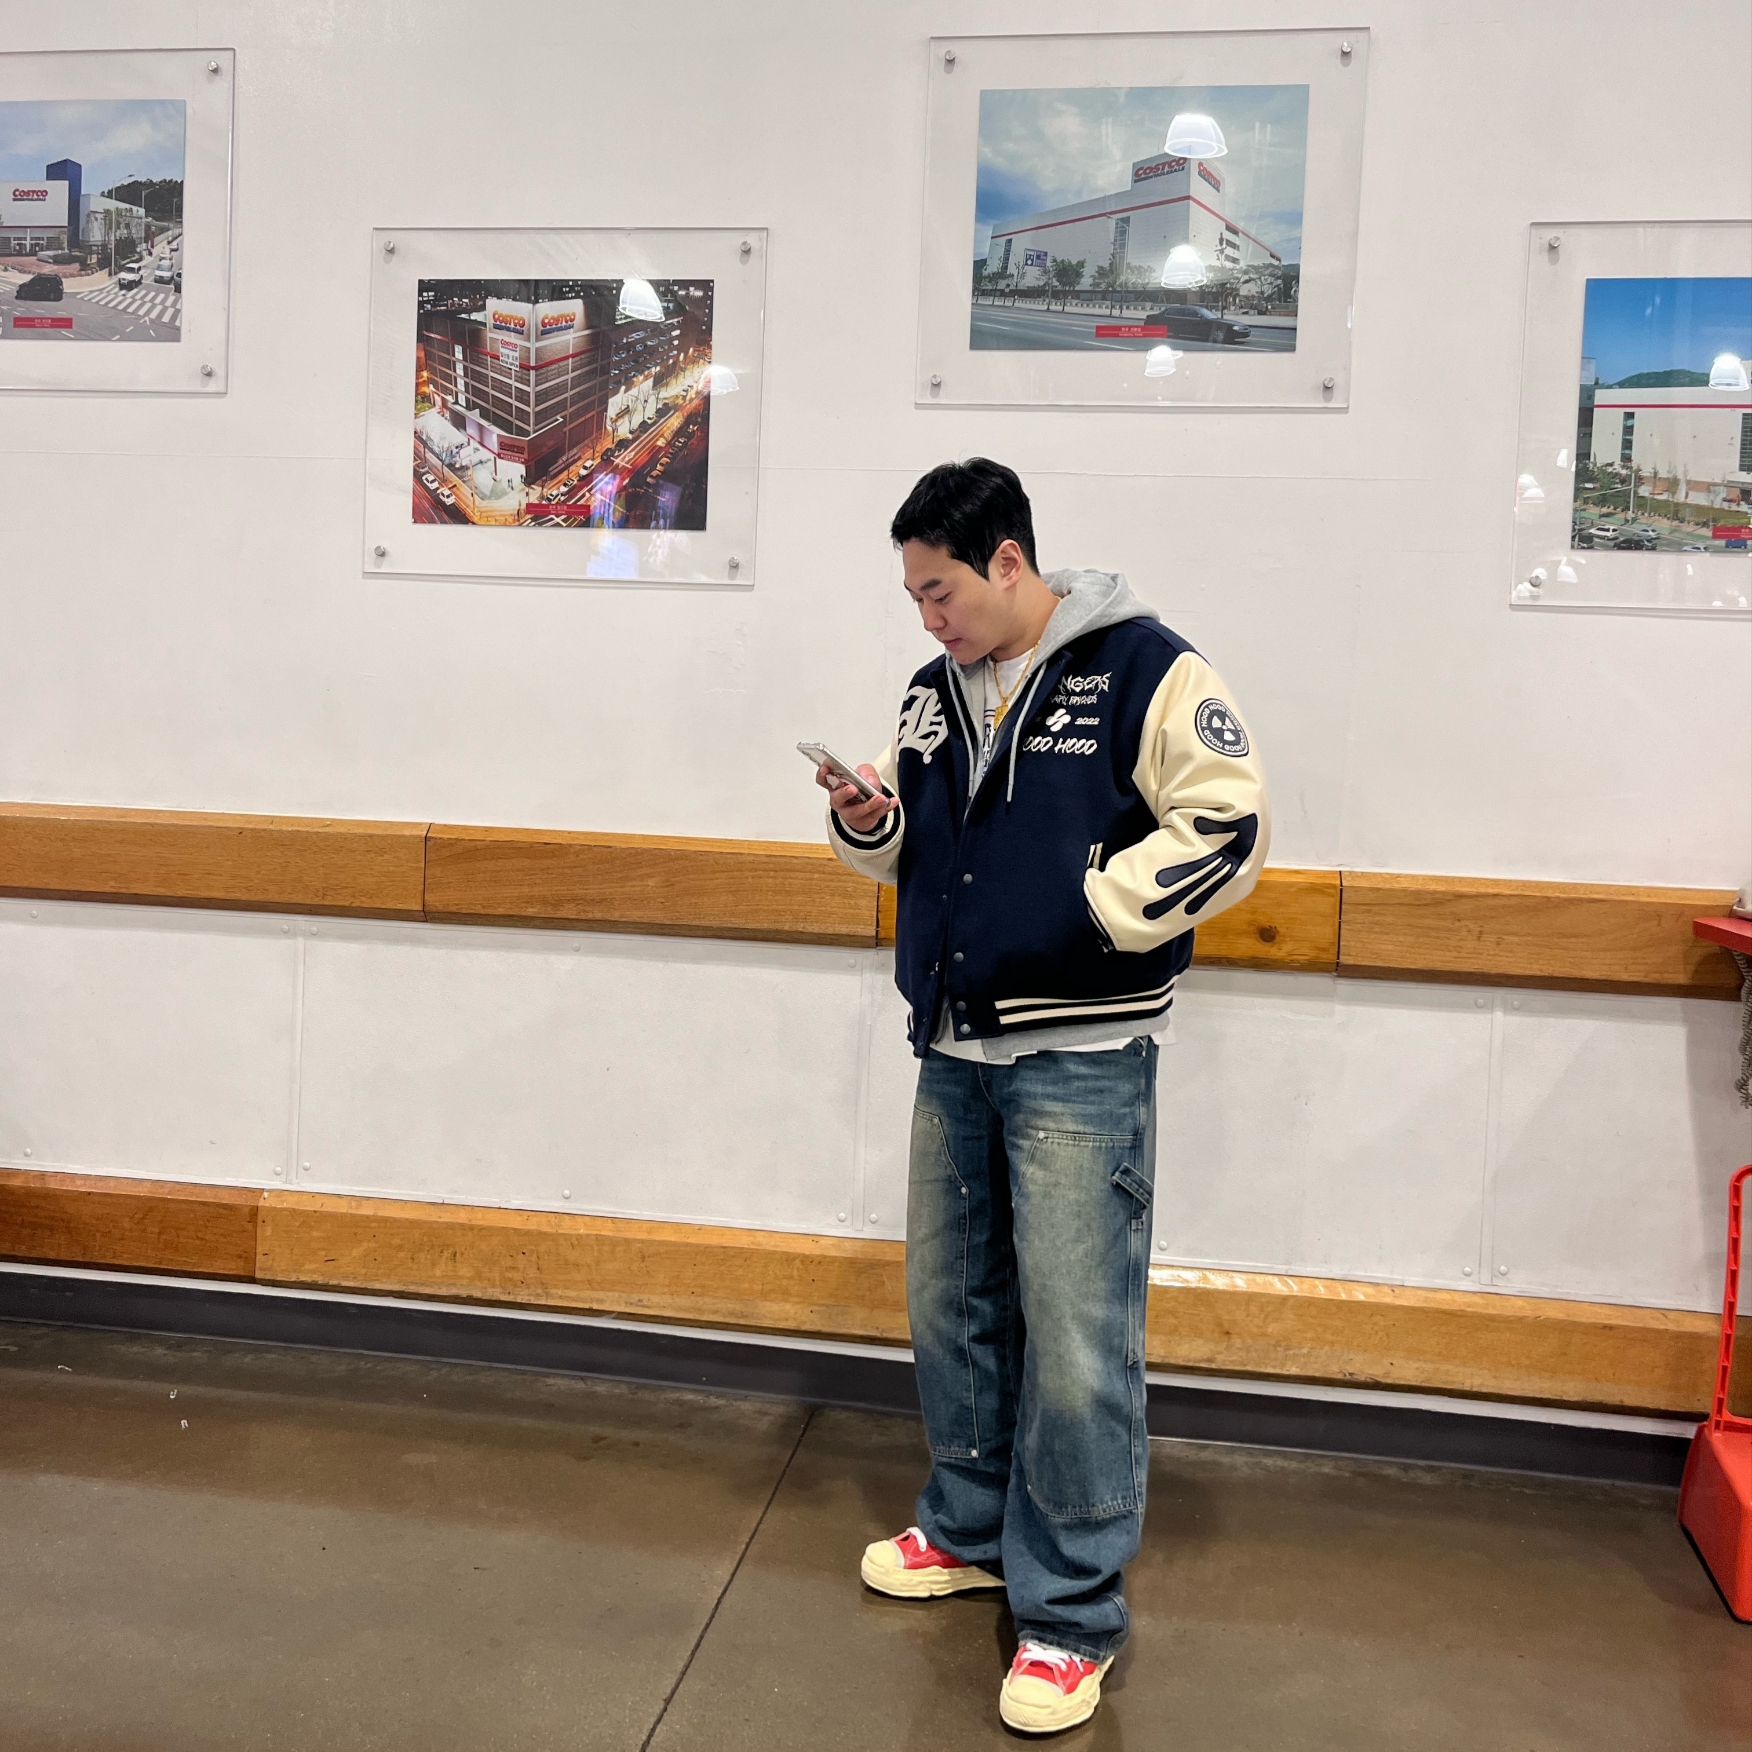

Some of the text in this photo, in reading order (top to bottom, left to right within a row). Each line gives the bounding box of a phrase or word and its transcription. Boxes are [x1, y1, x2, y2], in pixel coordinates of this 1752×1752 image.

[1134, 157, 1188, 178] COSTCO
[12, 188, 48, 198] COSTCO
[492, 310, 526, 328] COSTCO
[541, 312, 576, 328] COSTCO
[1074, 716, 1100, 725] 2022
[1200, 707, 1211, 728] HOOD
[1022, 735, 1098, 756] OOD HOOD
[1204, 730, 1223, 747] HOOD
